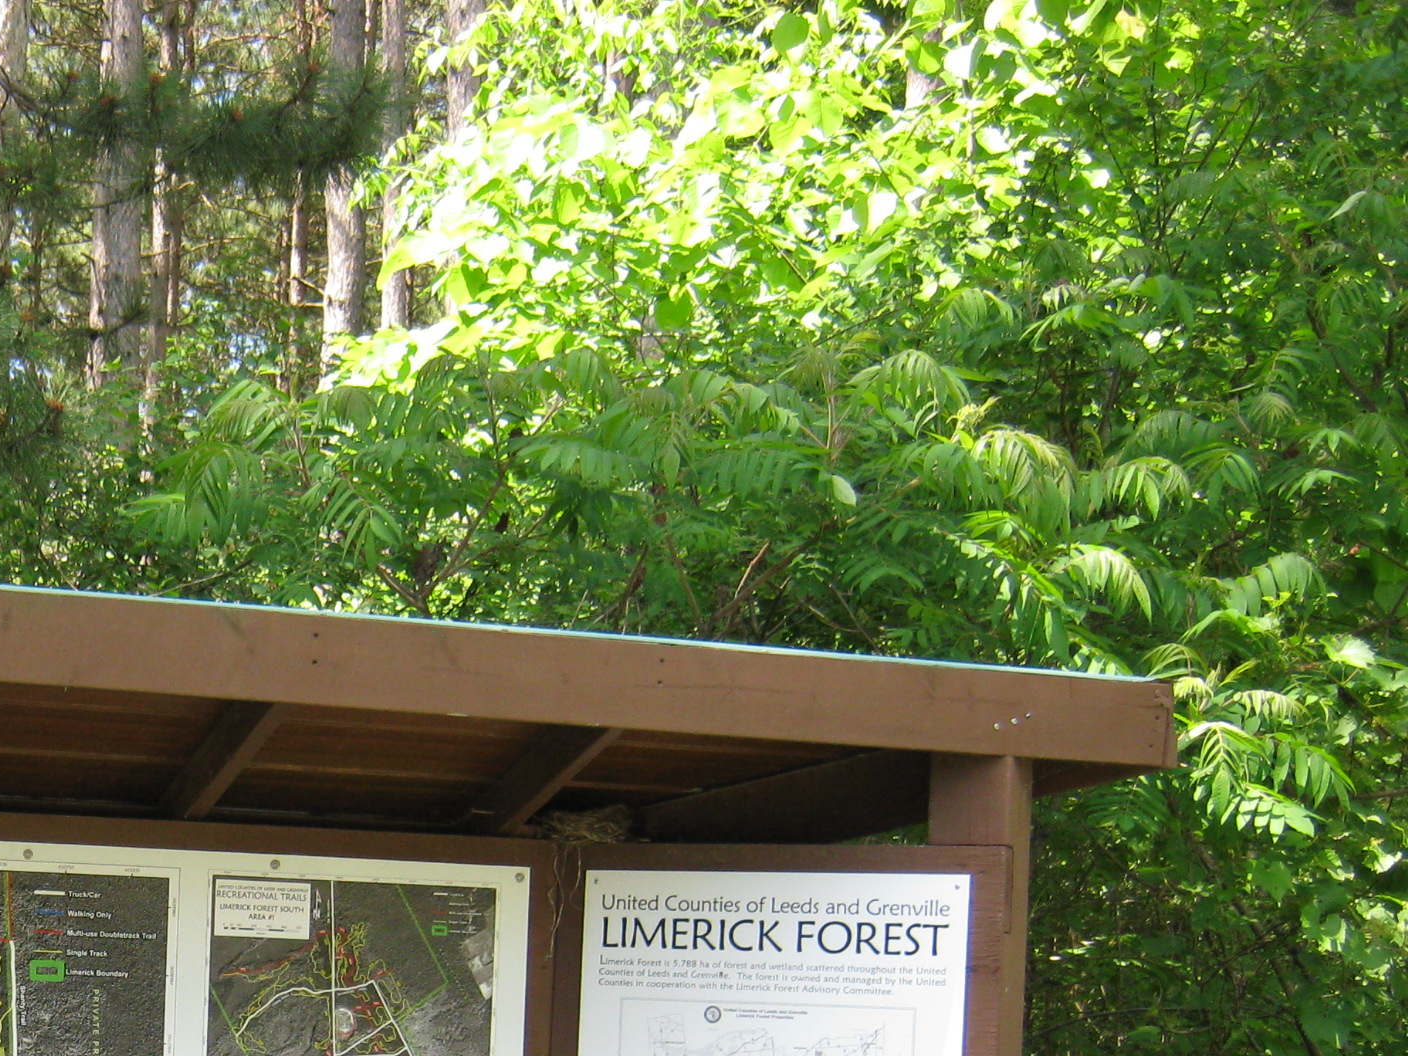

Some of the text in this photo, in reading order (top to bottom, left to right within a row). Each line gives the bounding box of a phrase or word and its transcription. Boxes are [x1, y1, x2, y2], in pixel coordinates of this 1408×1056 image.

[68, 891, 101, 899] Truck/Car
[217, 890, 306, 901] RECREATIONAL TRAILS
[602, 894, 950, 916] United Counties of Leeds and Grenville
[68, 910, 112, 920] Walking Only
[67, 929, 98, 938] Multi-use
[100, 931, 140, 939] Doubletrack
[602, 916, 949, 956] LIMERICK FOREST
[66, 950, 87, 958] Single
[599, 955, 634, 966] Limerick
[637, 959, 661, 967] Forest
[699, 960, 709, 968] ha
[724, 961, 747, 969] forest
[750, 962, 766, 970] and
[769, 963, 804, 971] wetland
[806, 964, 844, 972] scattered
[847, 965, 896, 976] throughout
[899, 966, 913, 975] the
[916, 967, 947, 976] United
[96, 970, 129, 978] Boundary
[599, 968, 634, 977] Counties
[636, 969, 645, 977] of
[648, 969, 670, 978] Leeds
[673, 970, 688, 978] and
[737, 972, 752, 980] The
[755, 973, 779, 981] forest
[791, 975, 820, 983] owned
[823, 975, 840, 983] and
[842, 976, 882, 986] managed
[885, 976, 895, 985] by
[899, 977, 913, 986] the
[916, 978, 946, 987] United
[598, 979, 633, 987] Counties
[646, 980, 696, 990] cooperation
[699, 982, 717, 990] with
[736, 983, 770, 991] Limerick
[774, 984, 799, 992] Forest
[802, 985, 840, 995] Advisory
[843, 986, 894, 995] Committee.
